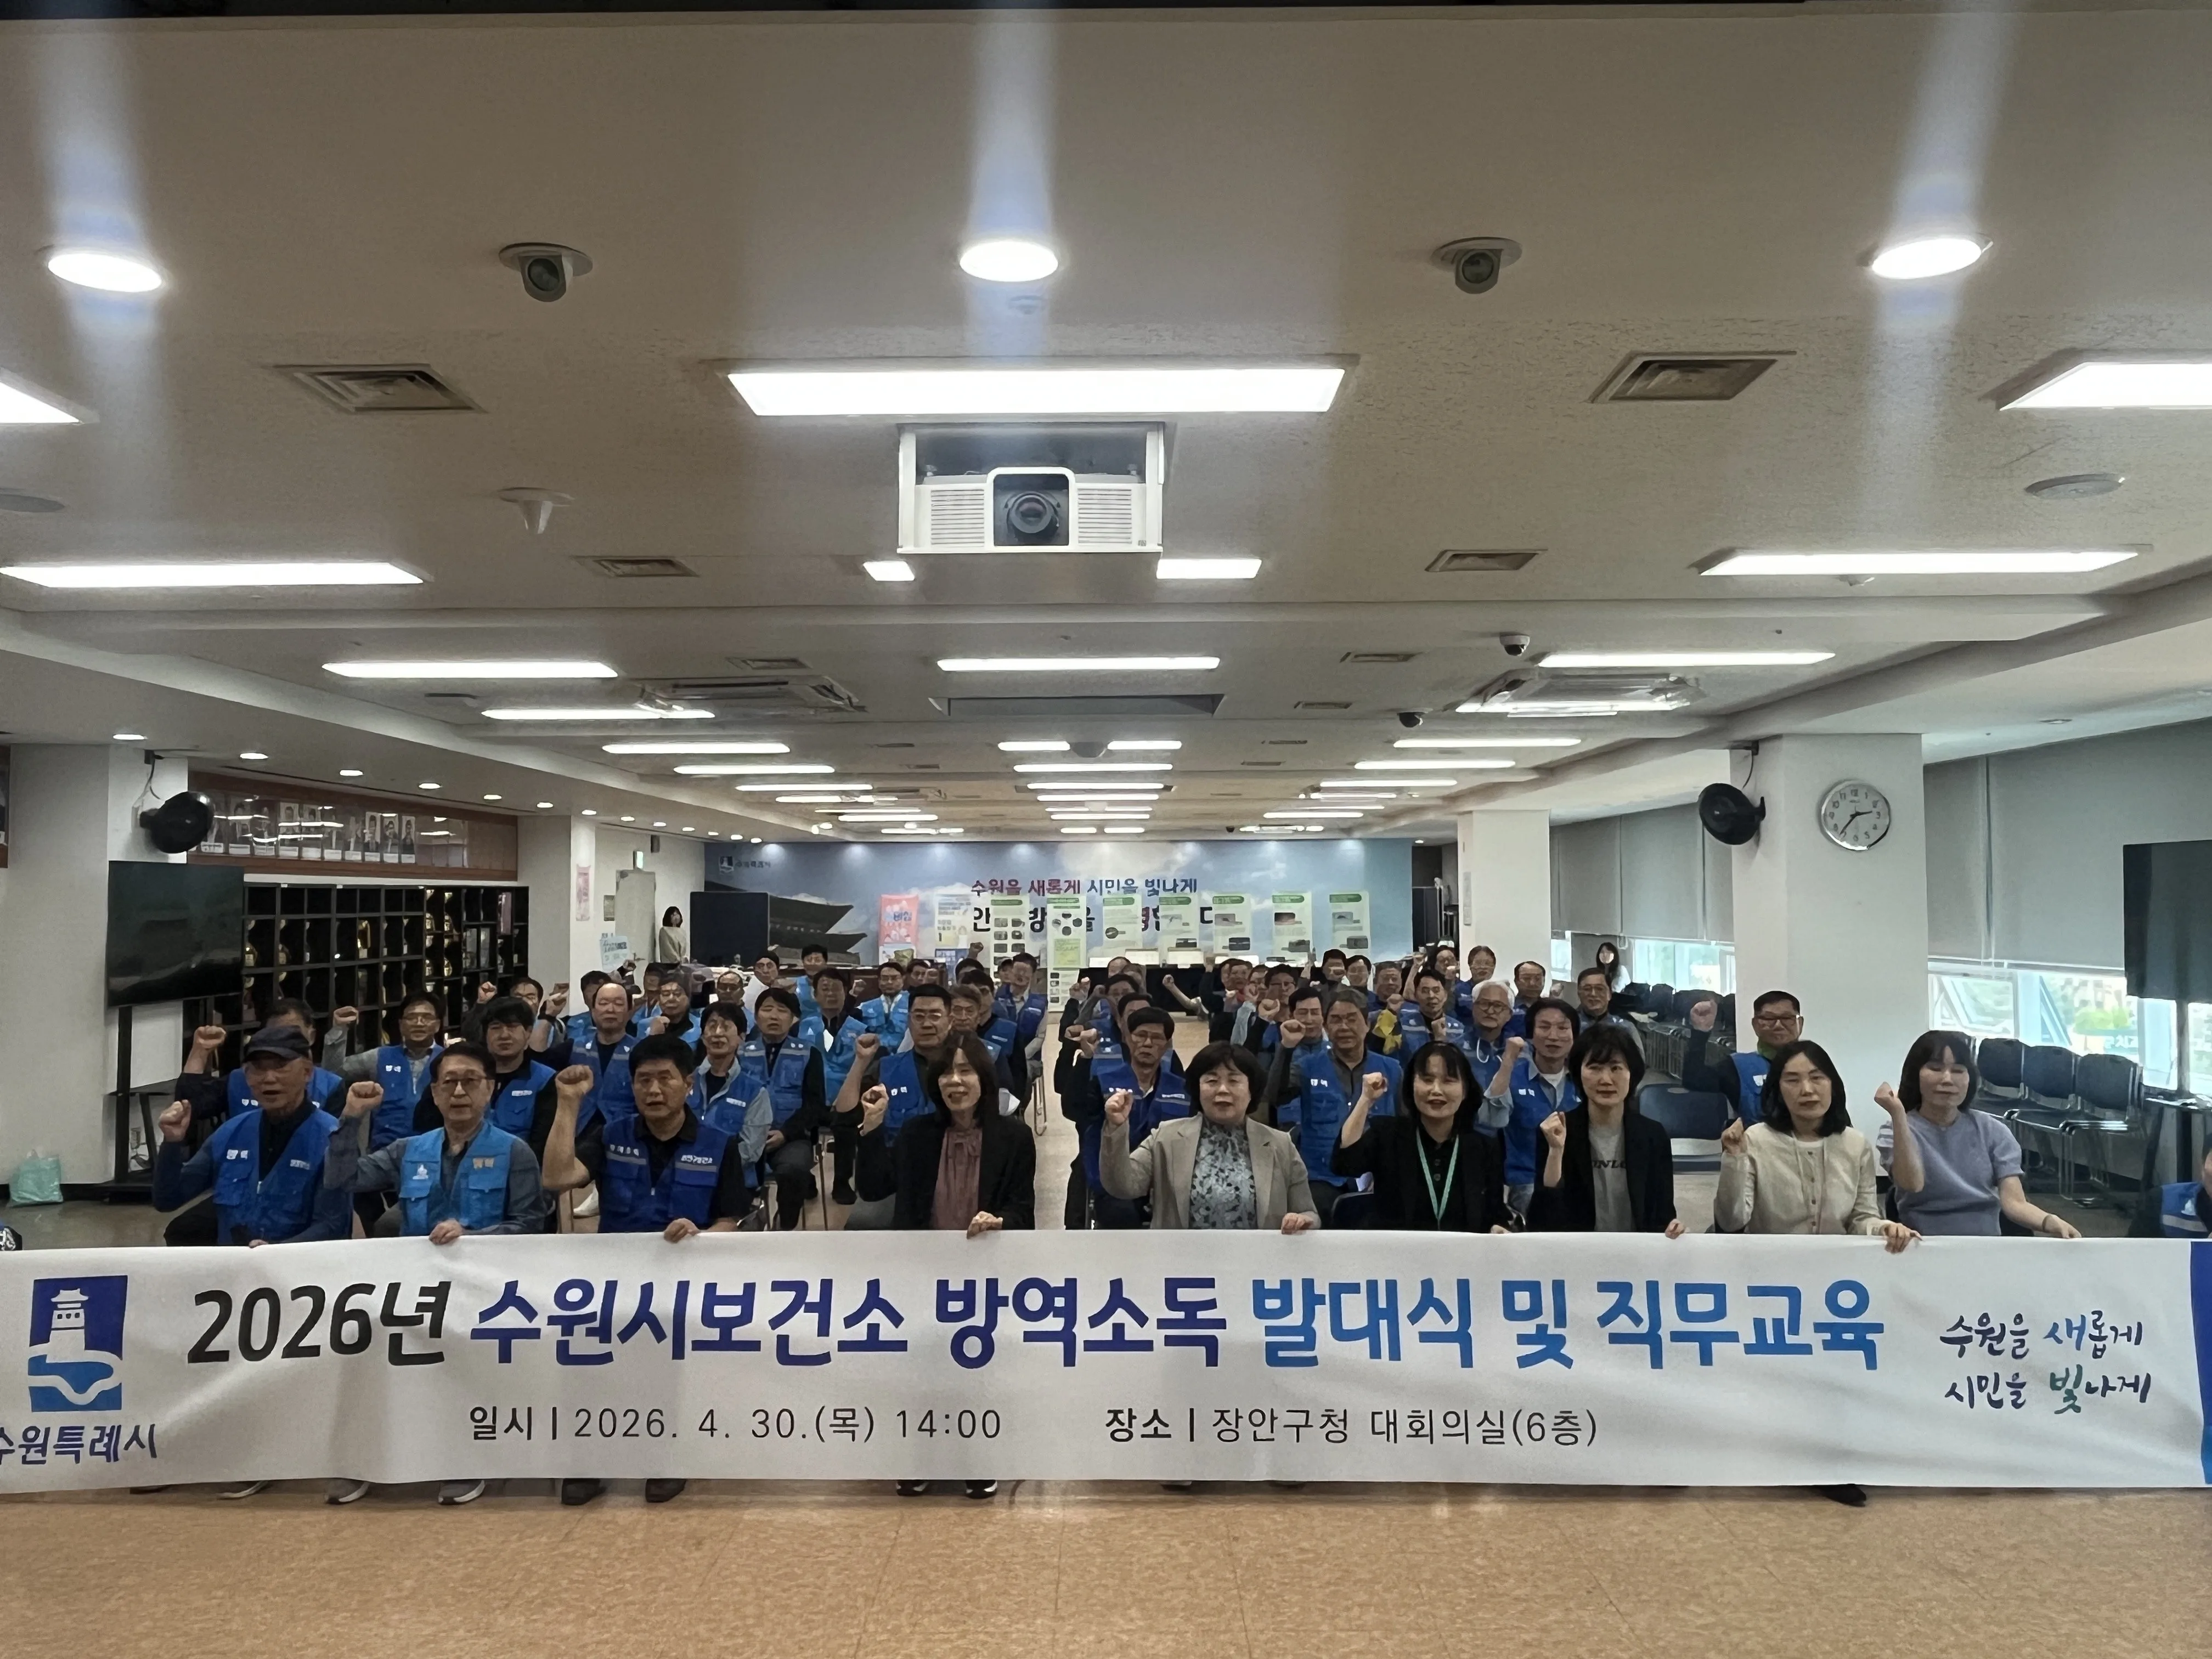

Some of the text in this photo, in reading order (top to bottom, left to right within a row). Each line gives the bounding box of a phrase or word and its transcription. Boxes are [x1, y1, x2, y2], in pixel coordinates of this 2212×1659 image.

[971, 878, 1197, 897] 수원을 새롭게 시민을 빛나게
[188, 1277, 1884, 1370] 2026년 수원시보건소 방역소독 발대식 및 직무교육
[1939, 1310, 2143, 1359] 수원을 새롭게
[1944, 1364, 2151, 1415] 시민을 빛나게
[470, 1406, 532, 1441] 일시
[574, 1408, 677, 1438] 2026.
[698, 1409, 730, 1438] 4.
[752, 1405, 874, 1443] 30.(목)
[896, 1409, 1000, 1438] 14:00
[1105, 1408, 1172, 1442] 장소
[1212, 1408, 1348, 1444] 장안구청
[1371, 1408, 1596, 1447] 대회의실(6층)
